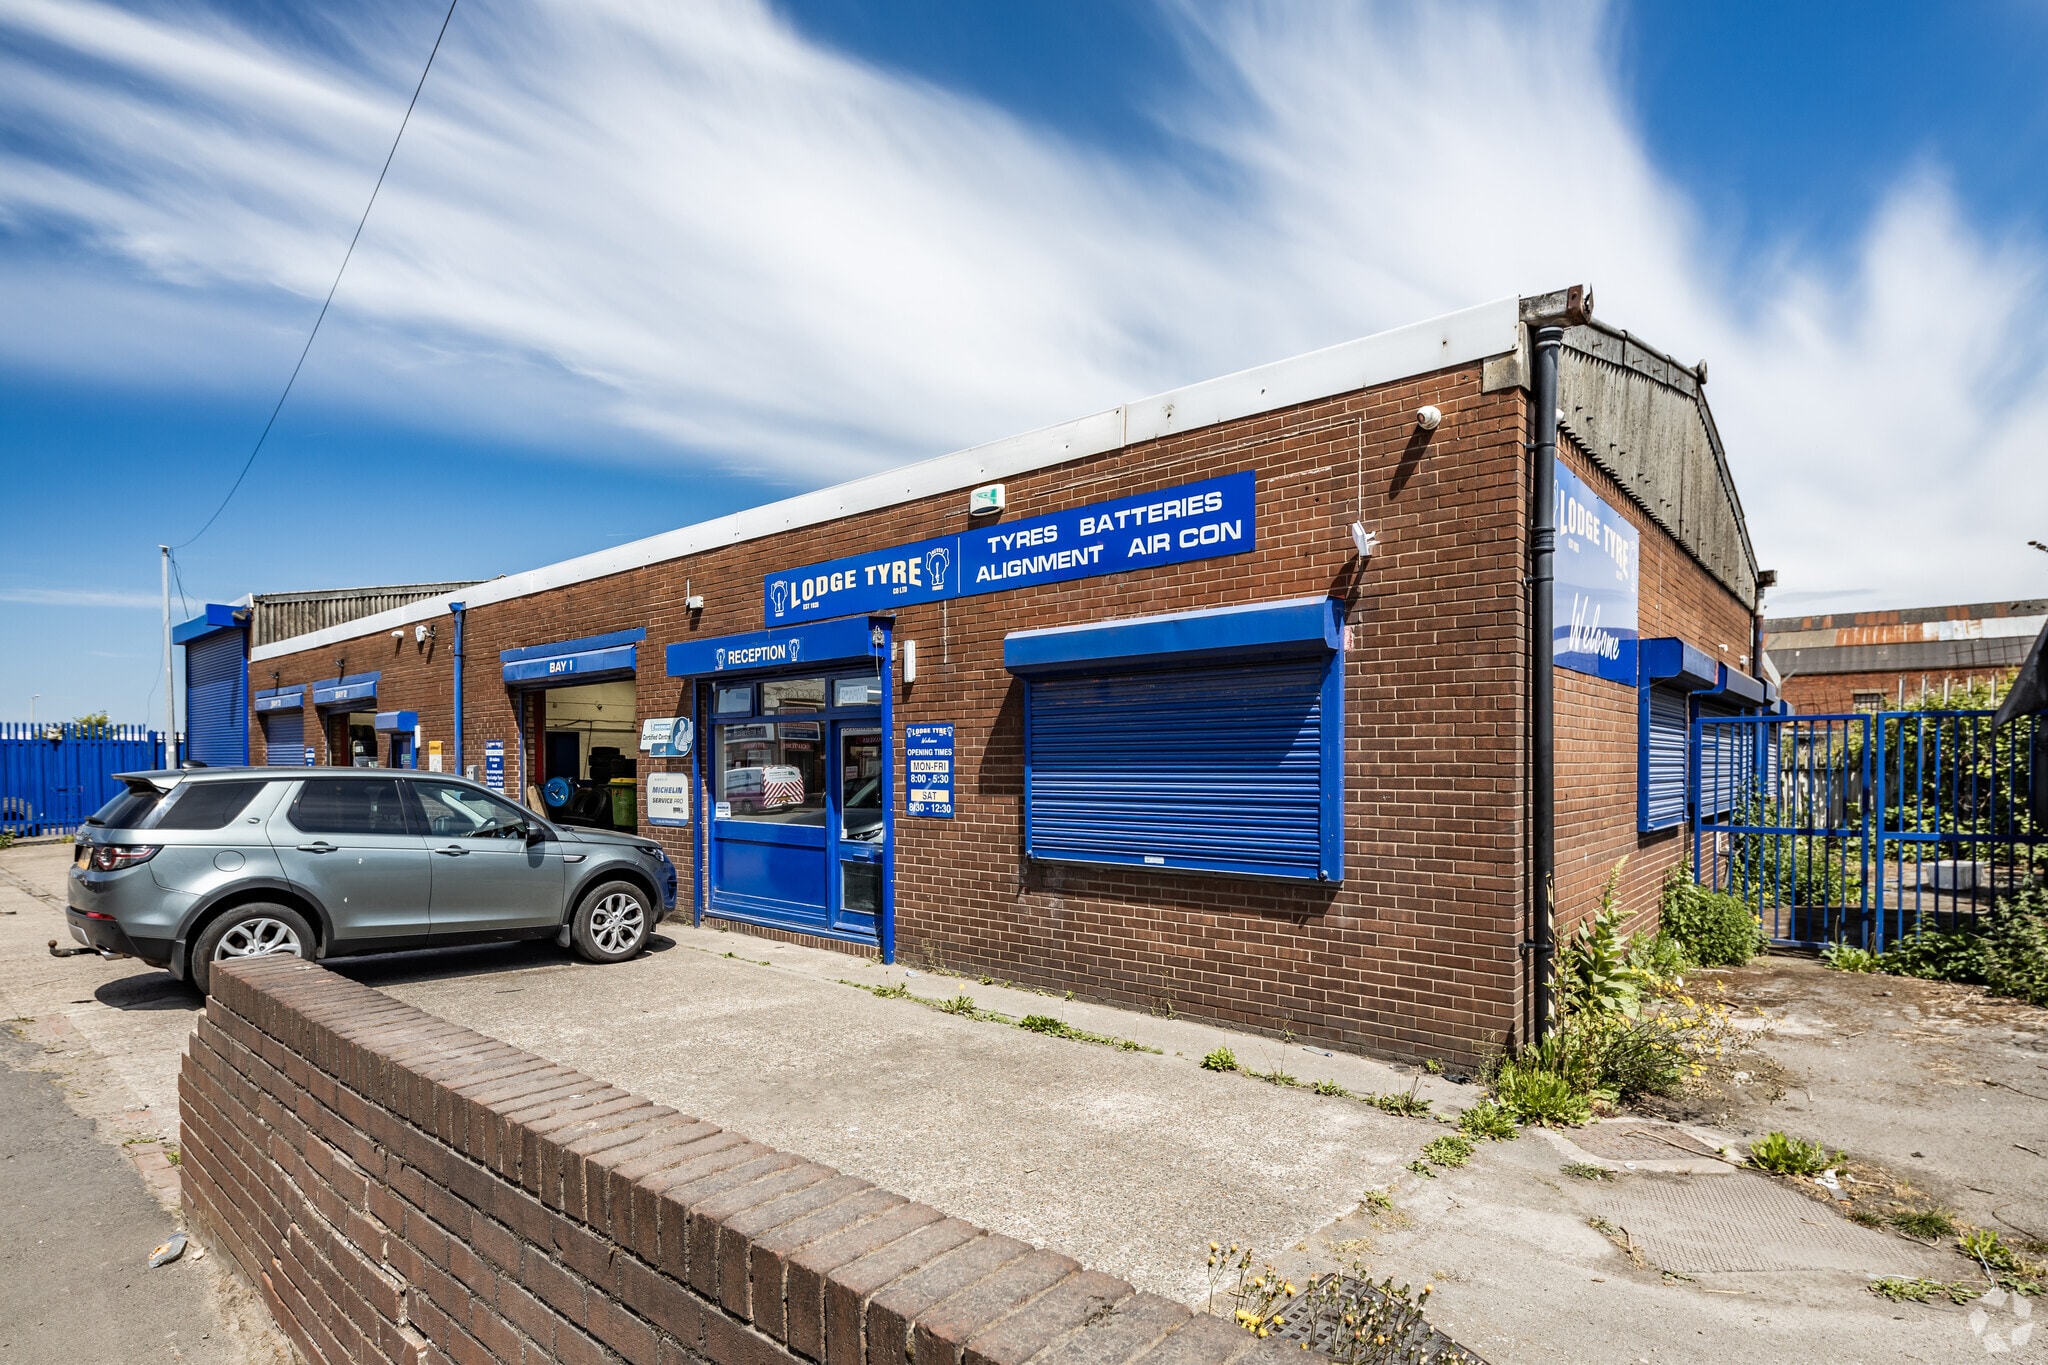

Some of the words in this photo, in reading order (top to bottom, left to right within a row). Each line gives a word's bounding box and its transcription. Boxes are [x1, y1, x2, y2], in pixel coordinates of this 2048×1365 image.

[987, 524, 1058, 553] TYRES
[1080, 491, 1223, 536] BATTERIES
[1560, 489, 1600, 546] LODGE
[1603, 523, 1630, 580] TYRE
[976, 545, 1104, 583] ALIGNMENT
[1128, 533, 1171, 557] AIR
[1179, 520, 1242, 549] CON
[791, 570, 857, 609] LODGE
[865, 556, 922, 587] TYRE
[1568, 591, 1620, 660] Welcome
[728, 644, 786, 665] RECEPTION
[549, 660, 567, 673] BAY
[569, 659, 573, 671] 1
[912, 728, 931, 736] LODGE
[932, 727, 947, 735] TYRE
[907, 748, 933, 756] OPENING
[934, 748, 952, 756] TIMES
[913, 762, 946, 771] MON-FRI
[910, 774, 926, 783] 8:00
[932, 774, 949, 784] 5:30
[652, 786, 683, 794] MICHELIN
[922, 791, 937, 800] SAT
[931, 803, 952, 813] 12:30
